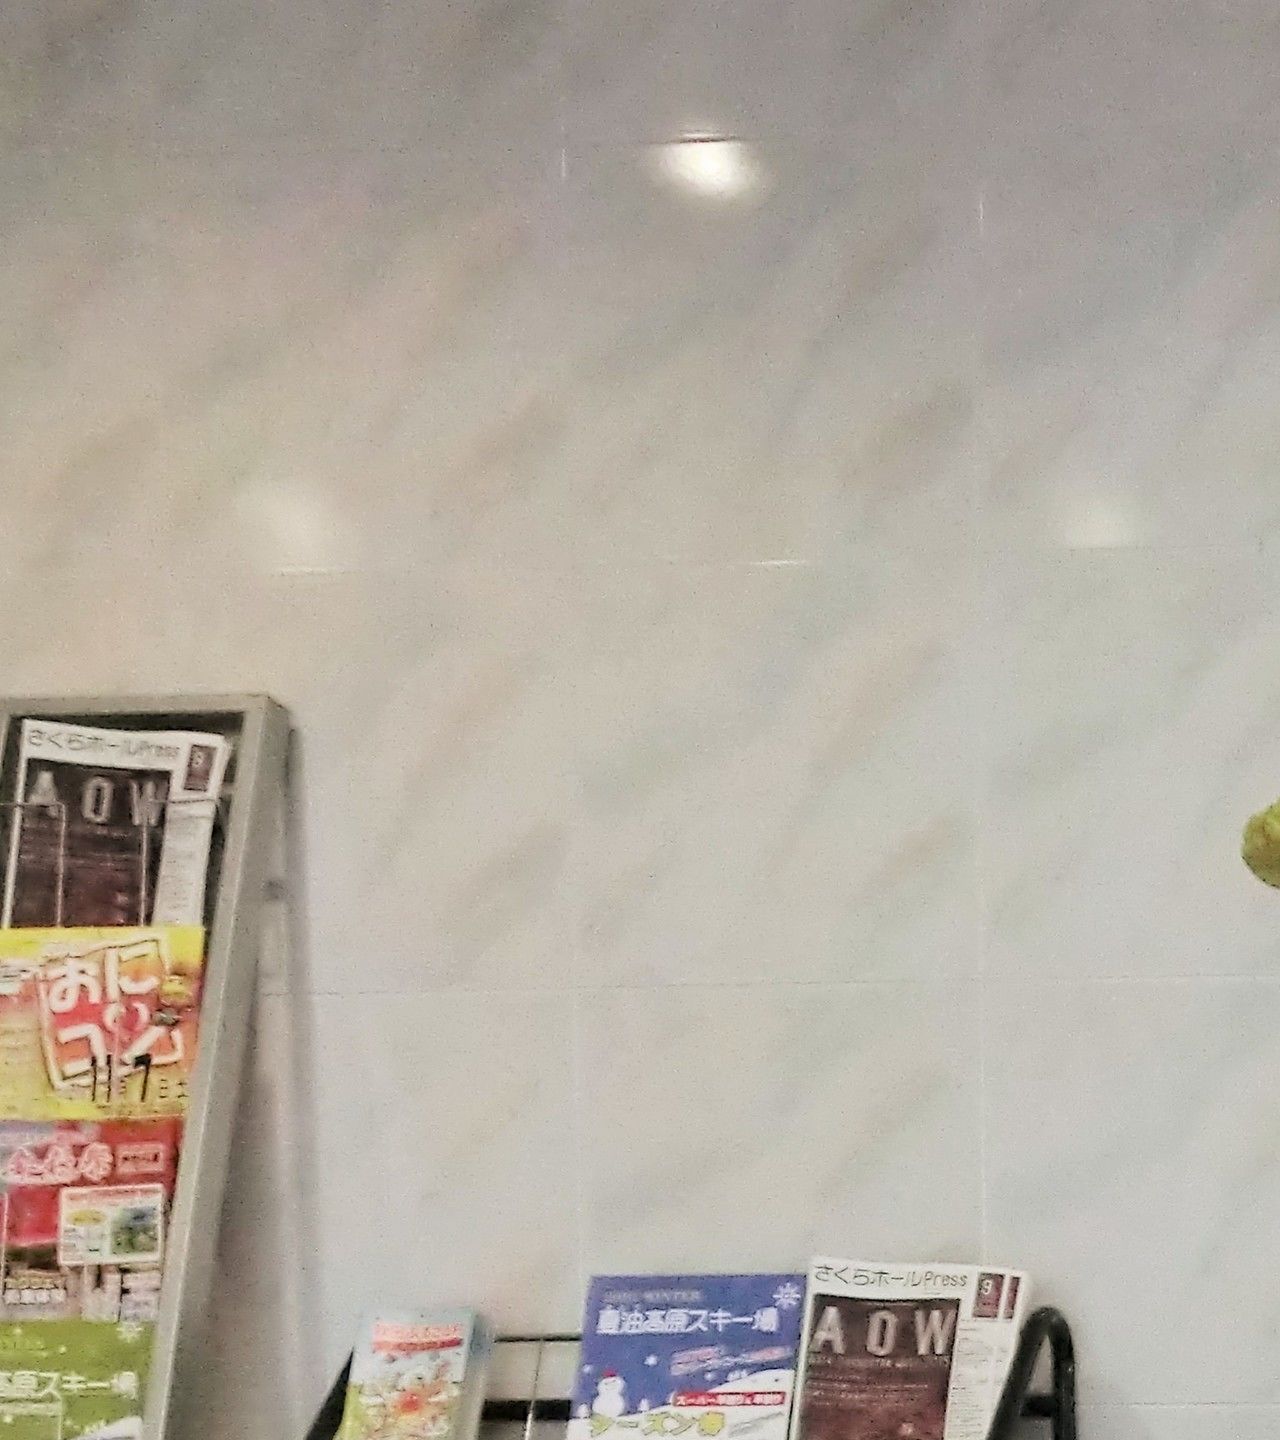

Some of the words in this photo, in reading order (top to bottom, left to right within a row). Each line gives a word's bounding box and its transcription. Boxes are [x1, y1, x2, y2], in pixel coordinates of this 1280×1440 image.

[813, 1264, 969, 1288] さくらホールPress
